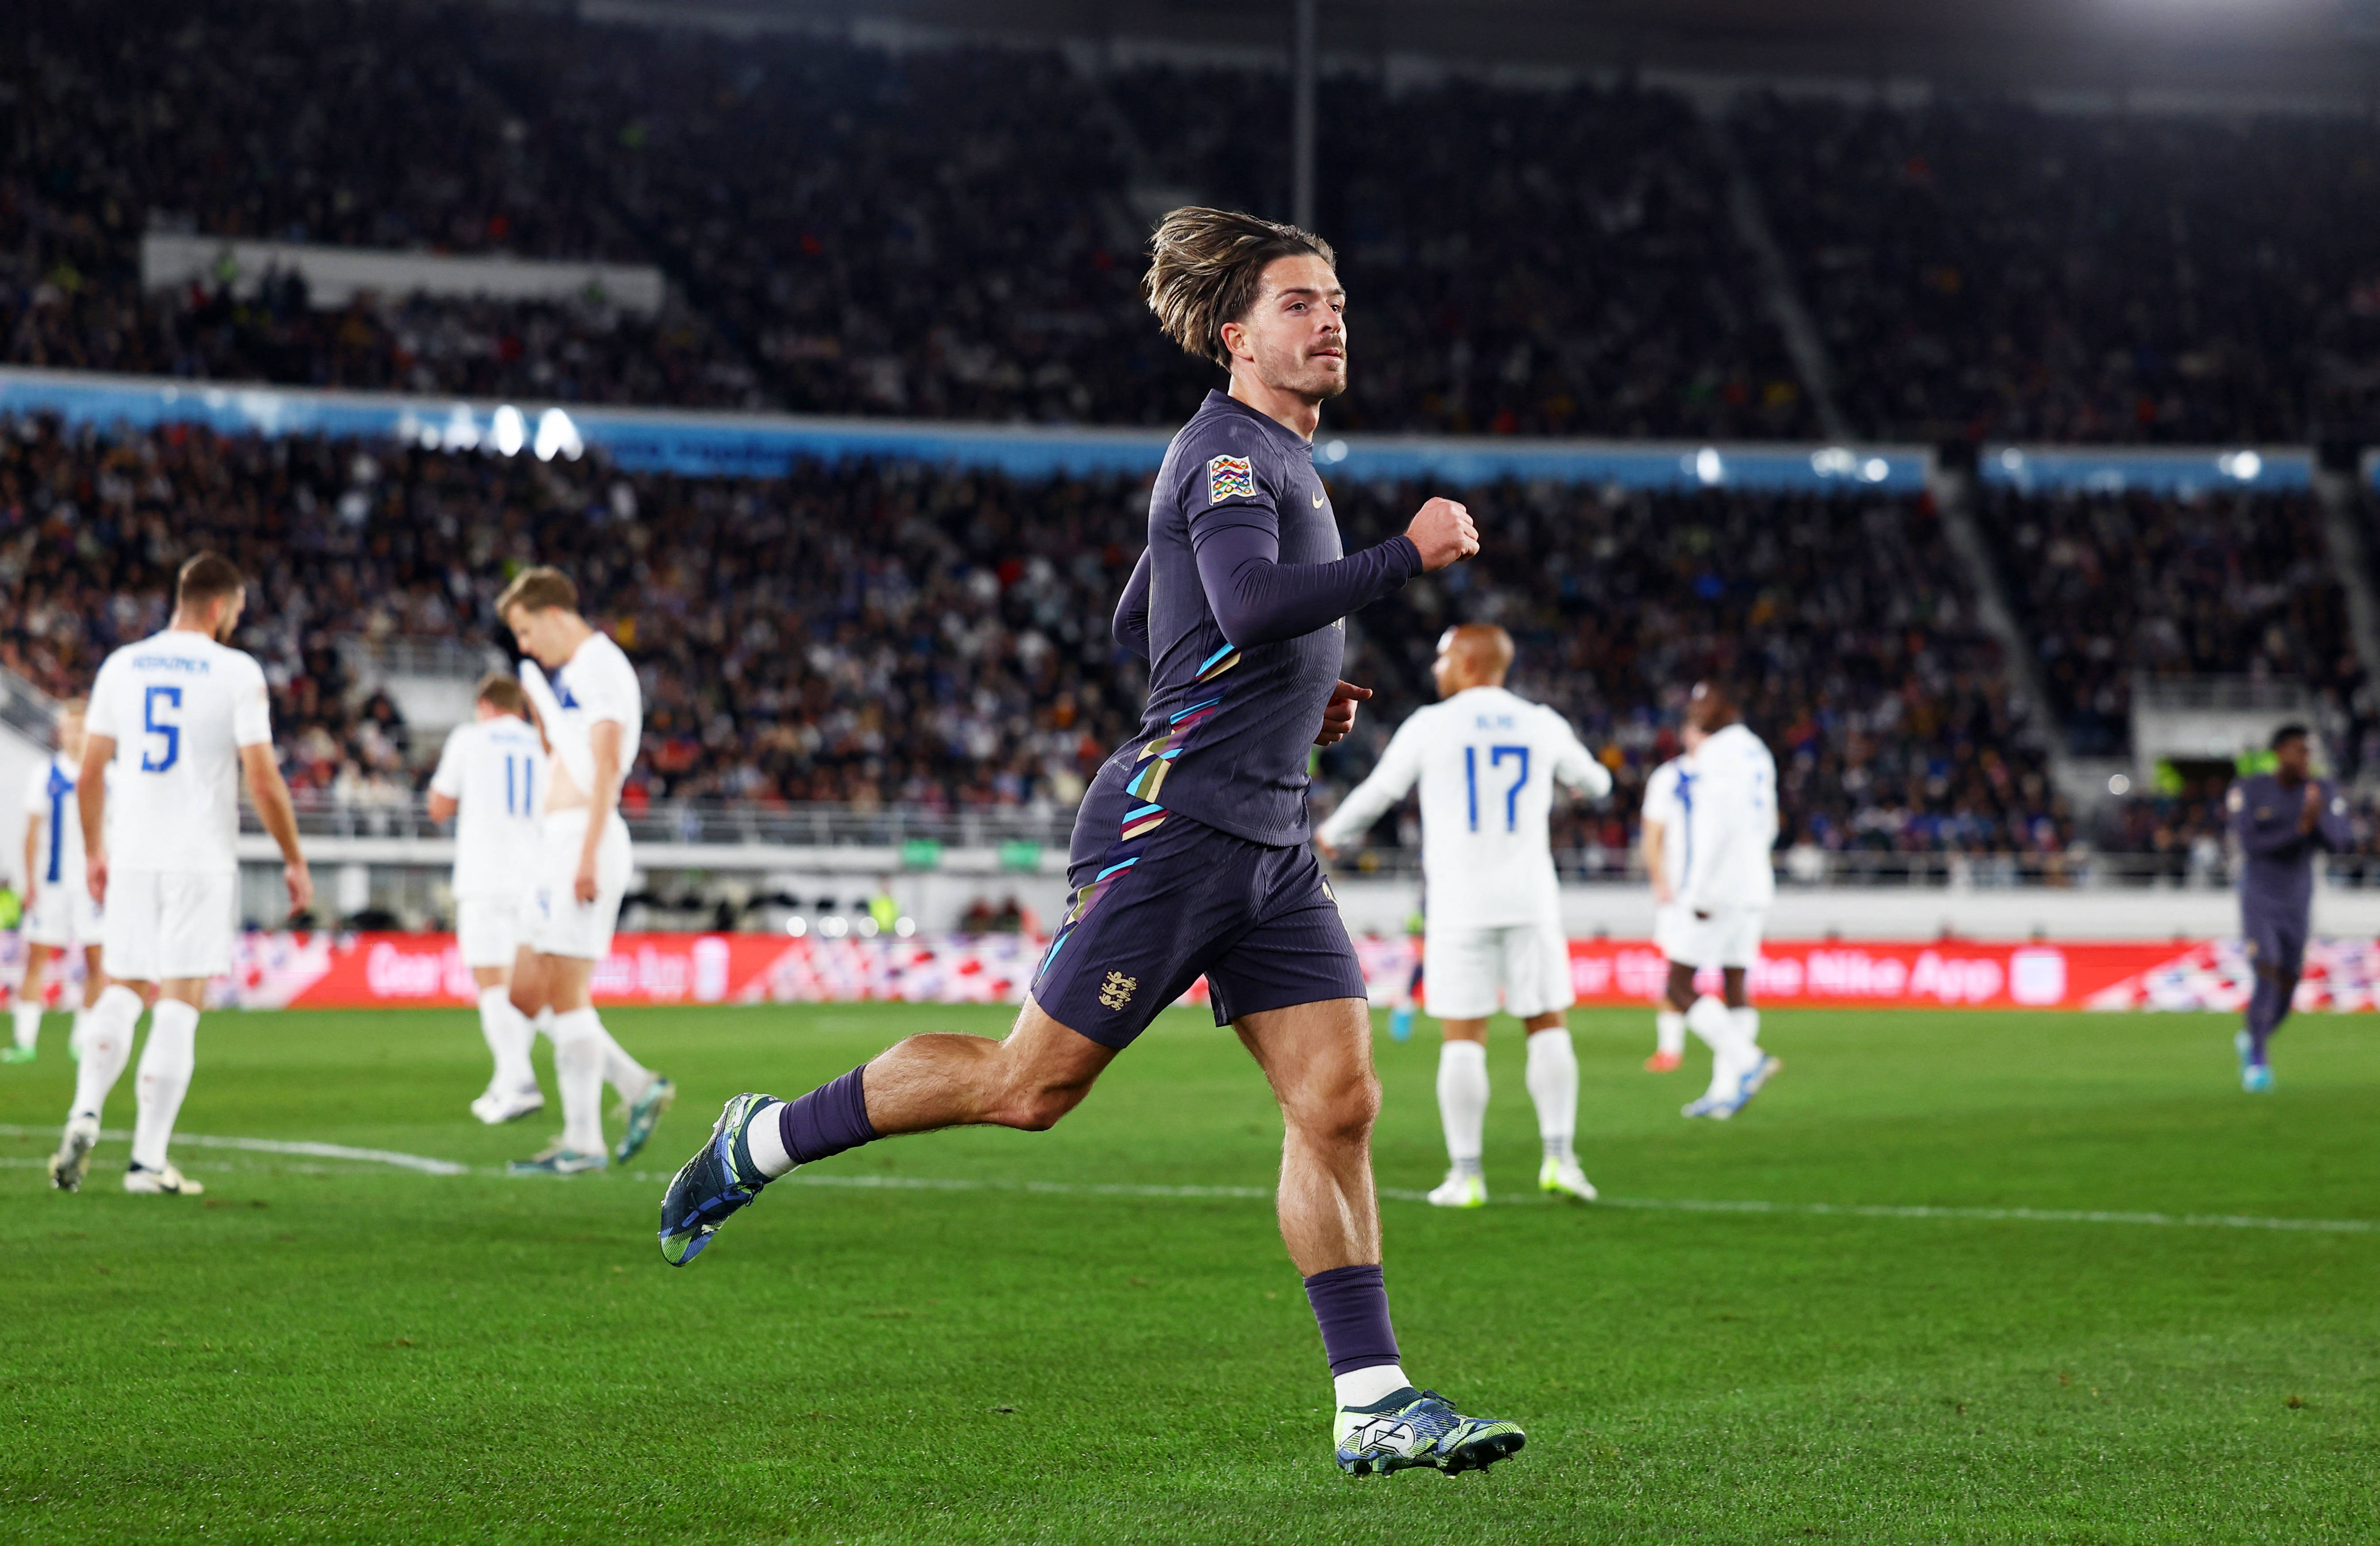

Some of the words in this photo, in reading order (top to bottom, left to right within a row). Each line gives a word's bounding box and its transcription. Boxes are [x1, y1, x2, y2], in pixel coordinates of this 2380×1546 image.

[141, 686, 181, 772] 5
[506, 754, 533, 816] 11
[1466, 746, 1529, 831] 17
[1806, 949, 1907, 997] Nike
[1909, 949, 2004, 1004] App
